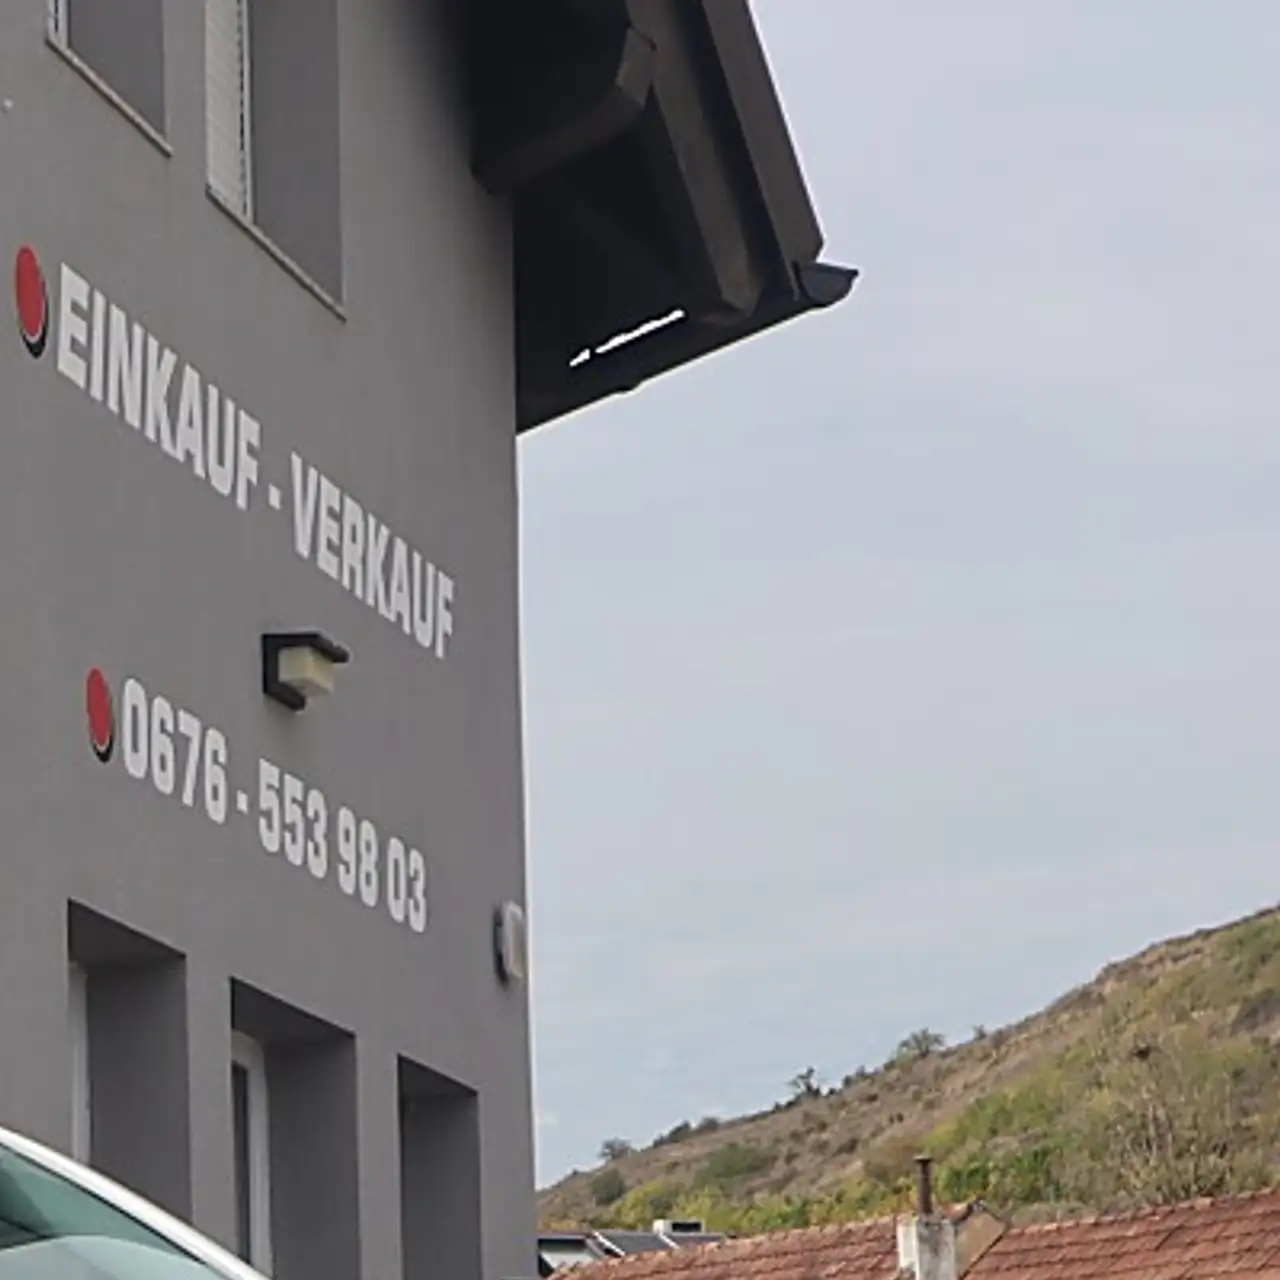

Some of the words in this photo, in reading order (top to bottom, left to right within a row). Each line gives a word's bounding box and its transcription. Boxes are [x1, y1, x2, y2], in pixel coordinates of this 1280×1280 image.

[57, 261, 262, 512] EINKAUF
[291, 450, 455, 660] VERKAUF
[123, 678, 228, 825] 0676
[259, 757, 328, 879] 553
[337, 806, 378, 908] 98
[387, 837, 426, 934] 03
